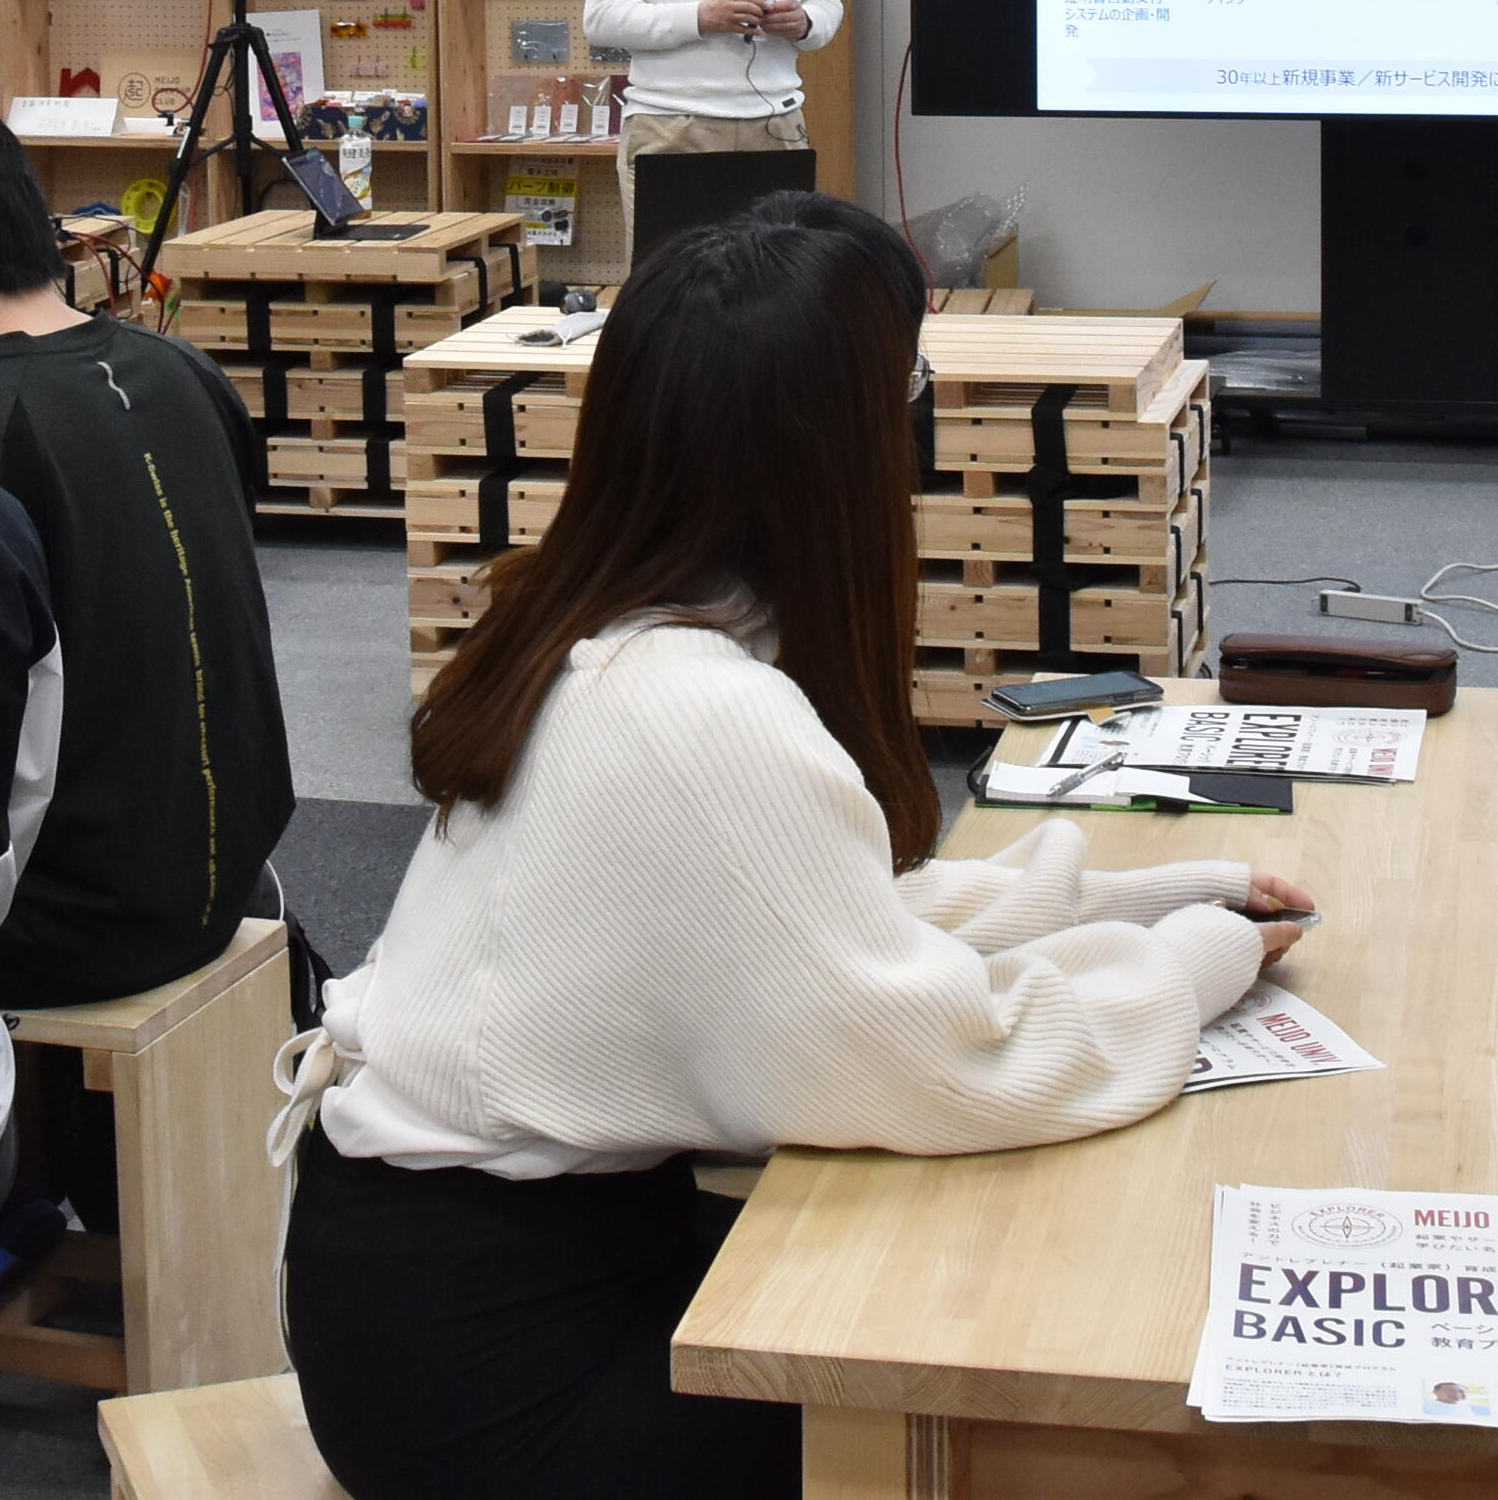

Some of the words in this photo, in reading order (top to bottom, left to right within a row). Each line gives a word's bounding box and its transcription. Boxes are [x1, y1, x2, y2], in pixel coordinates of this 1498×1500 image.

[1065, 8, 1170, 22] システムの企画・開
[1065, 24, 1079, 38] 発
[1180, 712, 1231, 743] BASIC
[1256, 1012, 1311, 1042] MEIJO
[1291, 1041, 1342, 1066] UNIV.
[1309, 1204, 1385, 1218] EXPLORER
[1414, 1208, 1491, 1229] MEIJO
[1233, 1309, 1406, 1348] BASIC
